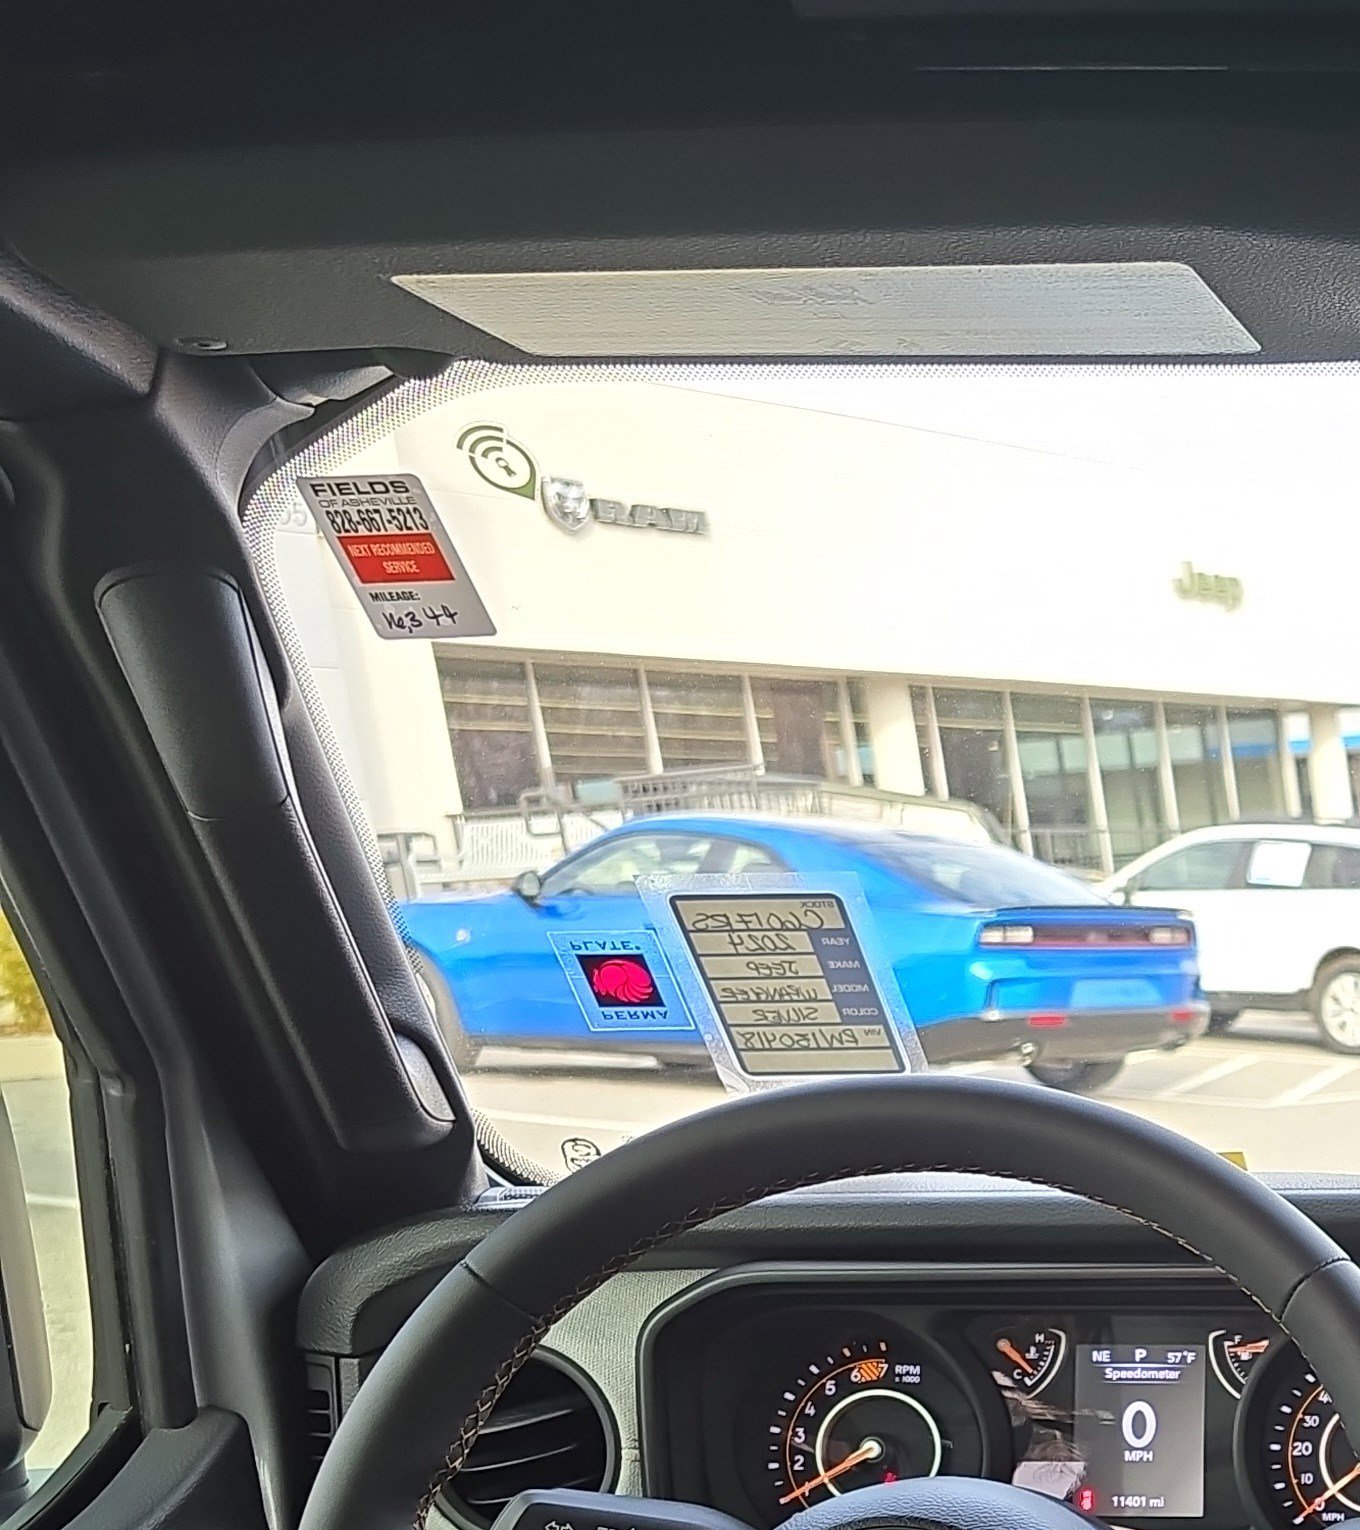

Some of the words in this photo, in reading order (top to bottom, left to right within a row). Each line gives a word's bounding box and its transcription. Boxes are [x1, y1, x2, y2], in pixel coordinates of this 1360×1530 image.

[310, 481, 410, 497] FIELDS
[319, 500, 339, 508] OF
[342, 497, 417, 507] ASHEVILLE
[326, 507, 430, 534] 828-667-5213
[588, 498, 706, 535] RAM
[348, 543, 372, 558] NEXT
[372, 542, 436, 557] RECOMMENDED
[383, 560, 420, 574] SERVICE
[369, 591, 421, 603] MILEAGE:
[1035, 1333, 1045, 1344] H
[1092, 1351, 1111, 1363] NE
[1135, 1349, 1147, 1363] P
[850, 1368, 861, 1383] 6
[879, 1364, 889, 1378] 7
[895, 1365, 921, 1375] RPM
[1014, 1370, 1023, 1381] C
[1105, 1369, 1181, 1382] Speedometer
[825, 1380, 837, 1396] 5
[804, 1401, 817, 1417] 4
[1122, 1400, 1157, 1449] 0
[1303, 1415, 1320, 1428] 30
[794, 1427, 806, 1444] 3
[1124, 1451, 1154, 1462] MPH
[1292, 1442, 1313, 1457] 20
[793, 1455, 805, 1471] 2
[1301, 1473, 1314, 1485] 10
[1112, 1496, 1147, 1508] 11401
[1149, 1496, 1165, 1508] mi
[1322, 1513, 1345, 1523] MPH
